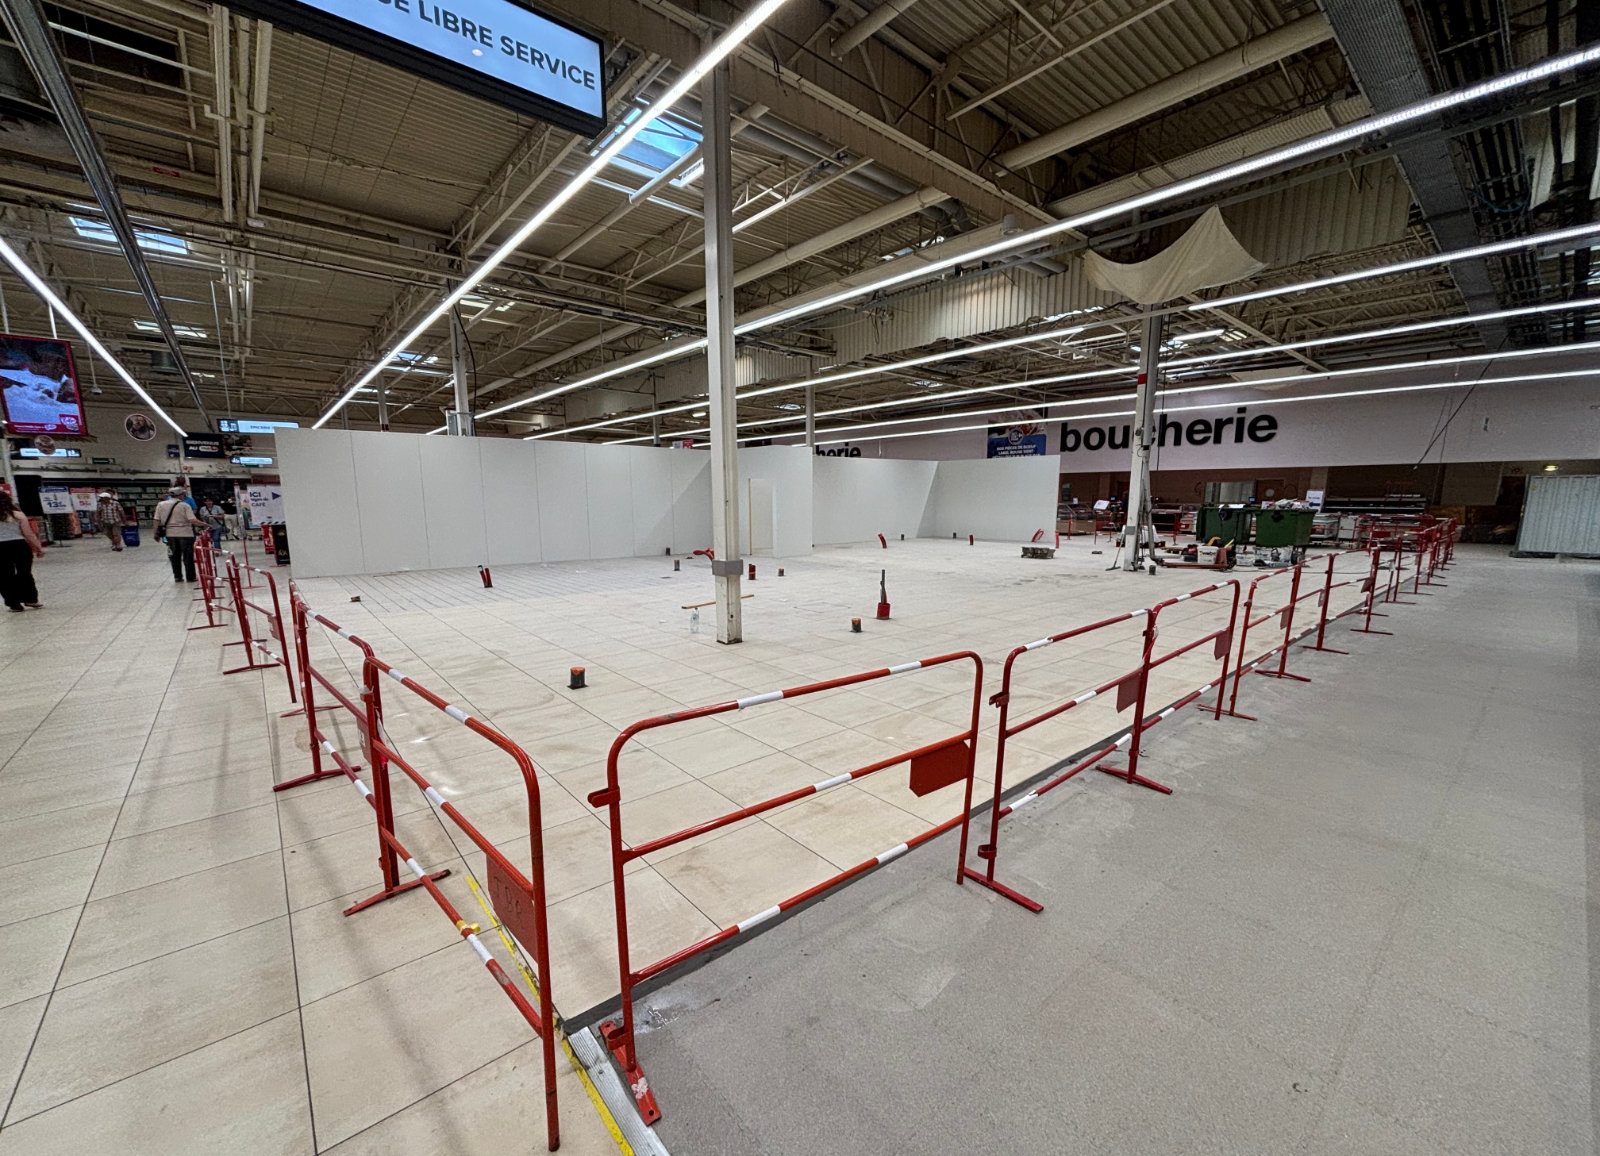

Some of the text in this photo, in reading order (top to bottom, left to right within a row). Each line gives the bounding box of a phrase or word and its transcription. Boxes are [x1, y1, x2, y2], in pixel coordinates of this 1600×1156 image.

[378, 0, 595, 90] E LIBRE SERVICE
[1060, 407, 1278, 452] bouherie
